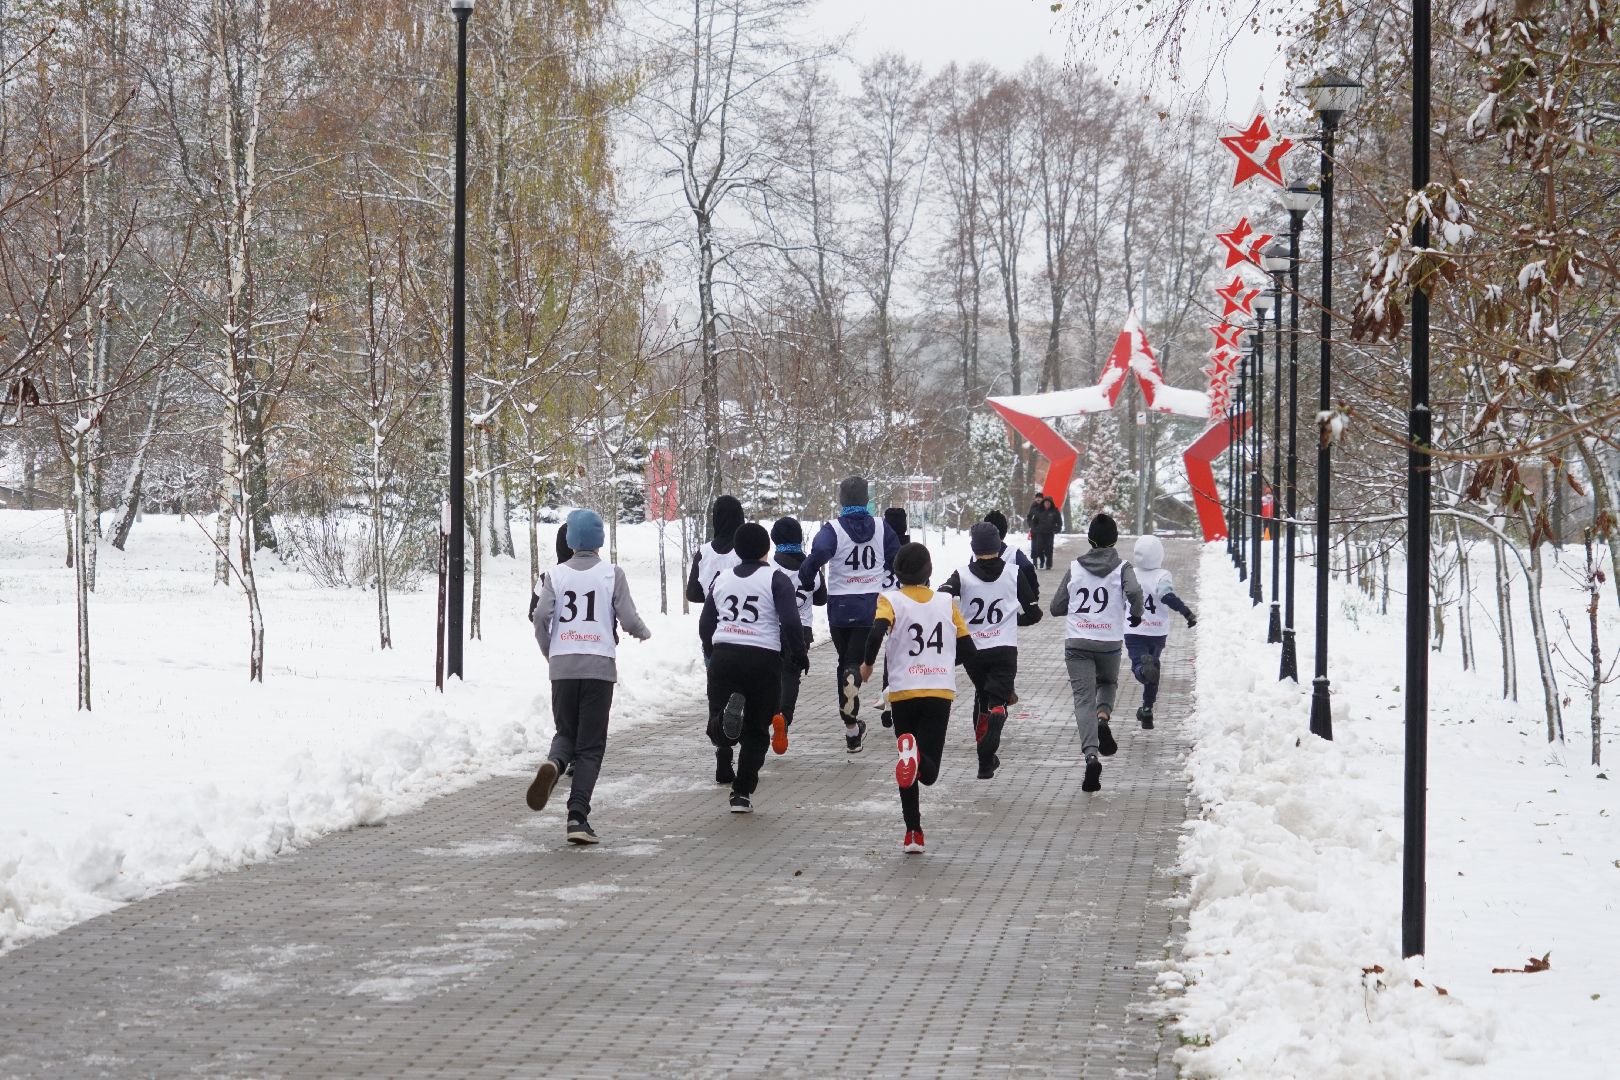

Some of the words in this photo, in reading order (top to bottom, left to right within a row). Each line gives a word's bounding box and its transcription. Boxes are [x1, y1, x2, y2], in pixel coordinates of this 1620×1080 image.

[844, 545, 876, 571] 40
[559, 590, 599, 623] 31
[722, 594, 760, 624] 35
[968, 597, 1004, 625] 26
[1074, 586, 1109, 614] 29
[907, 621, 944, 657] 34
